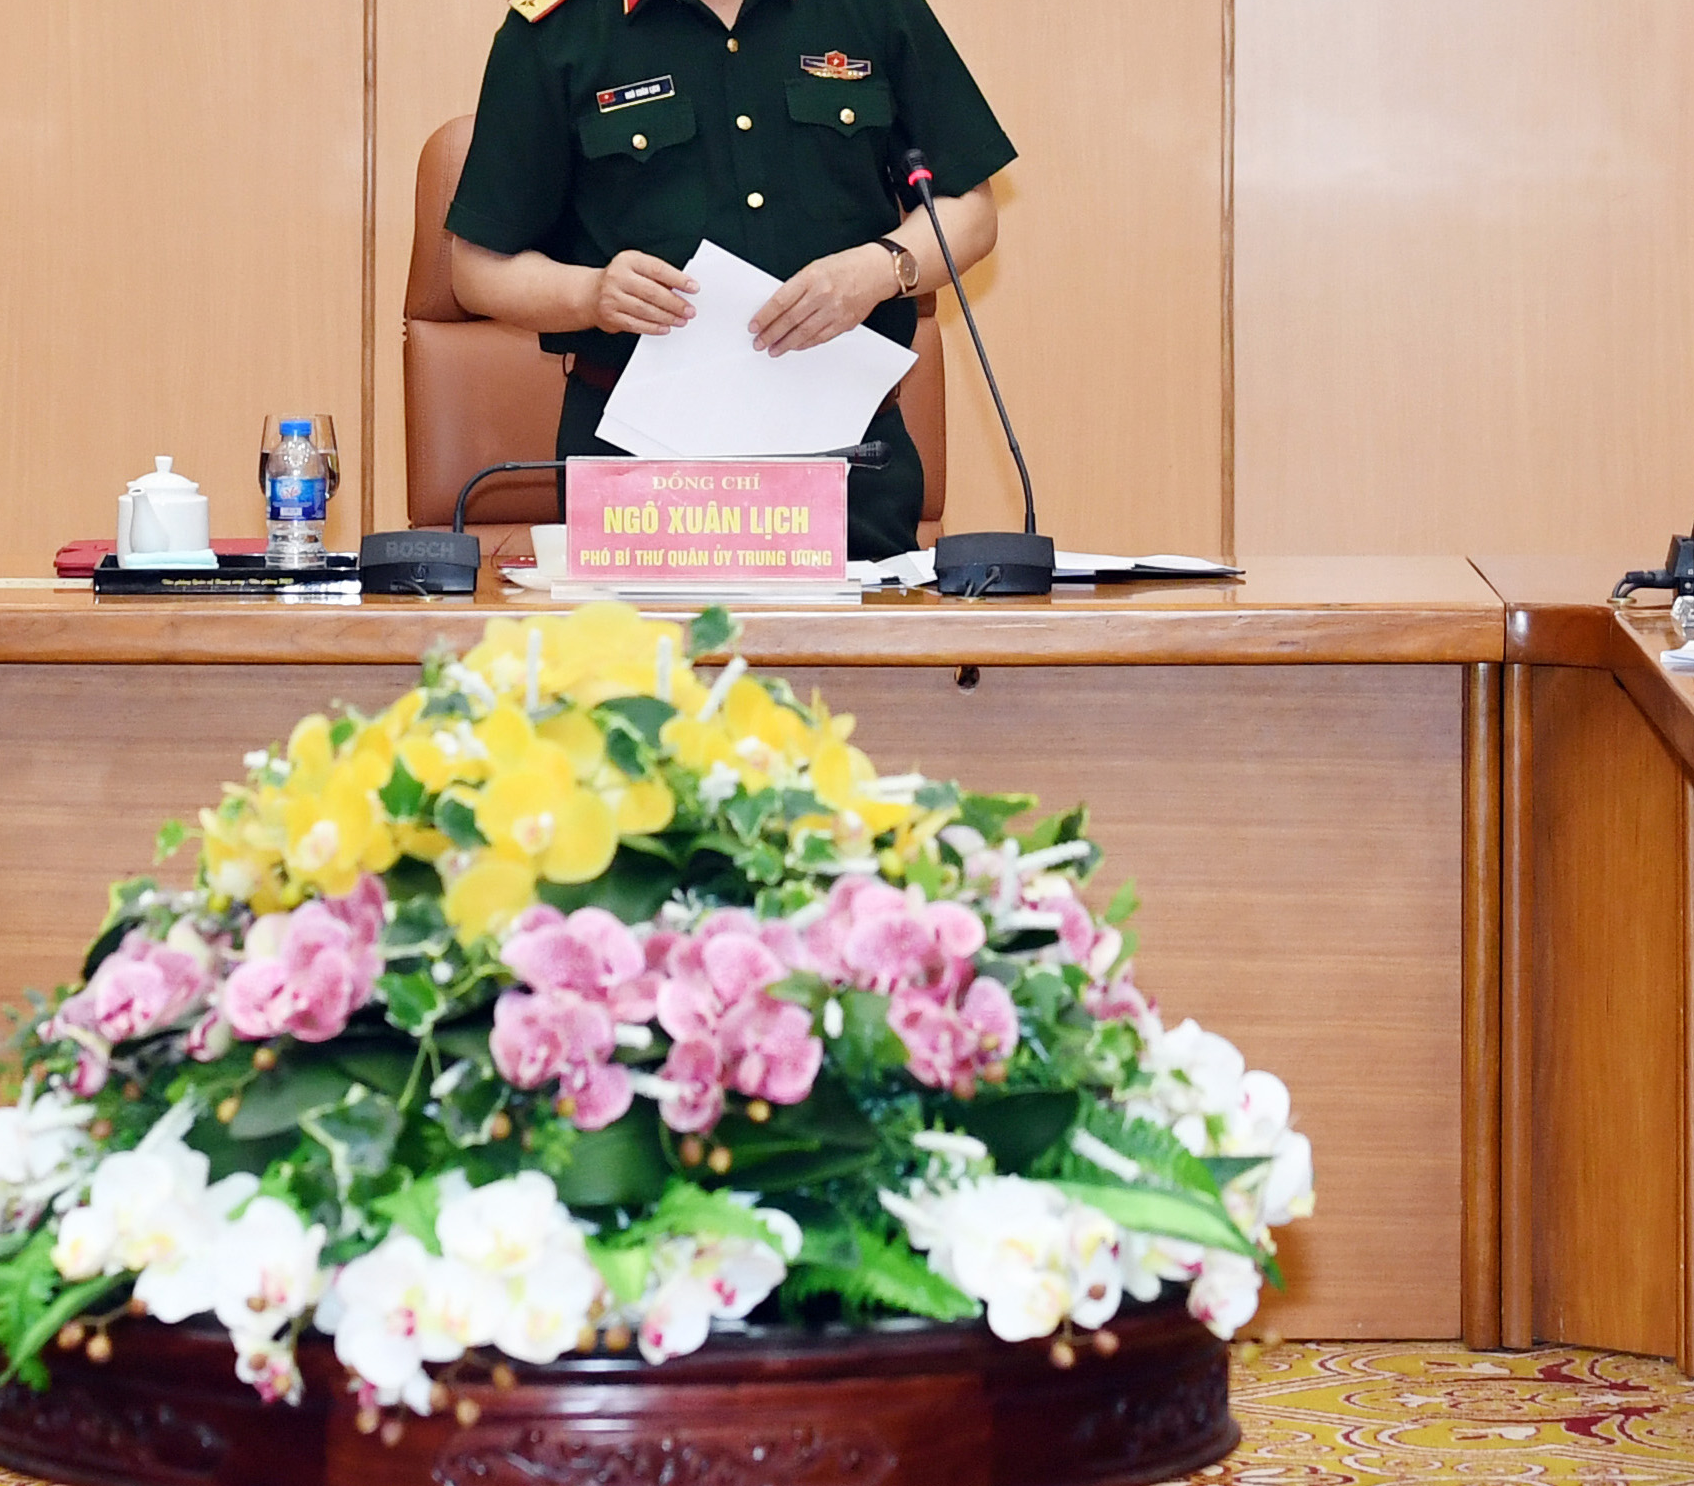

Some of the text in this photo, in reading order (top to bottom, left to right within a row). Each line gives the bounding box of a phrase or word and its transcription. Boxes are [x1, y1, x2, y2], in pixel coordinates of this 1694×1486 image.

[652, 470, 761, 491] ĐỒNG CHÍ
[603, 500, 809, 540] NGÔ XUÂN LỊCH
[385, 541, 455, 558] BOSCH
[580, 547, 610, 566] PHÓ
[614, 547, 631, 566] BÍ
[635, 547, 665, 566] THƯ
[667, 547, 709, 567] QUÂN
[713, 545, 733, 566] ỦY
[737, 549, 787, 566] TRUNG
